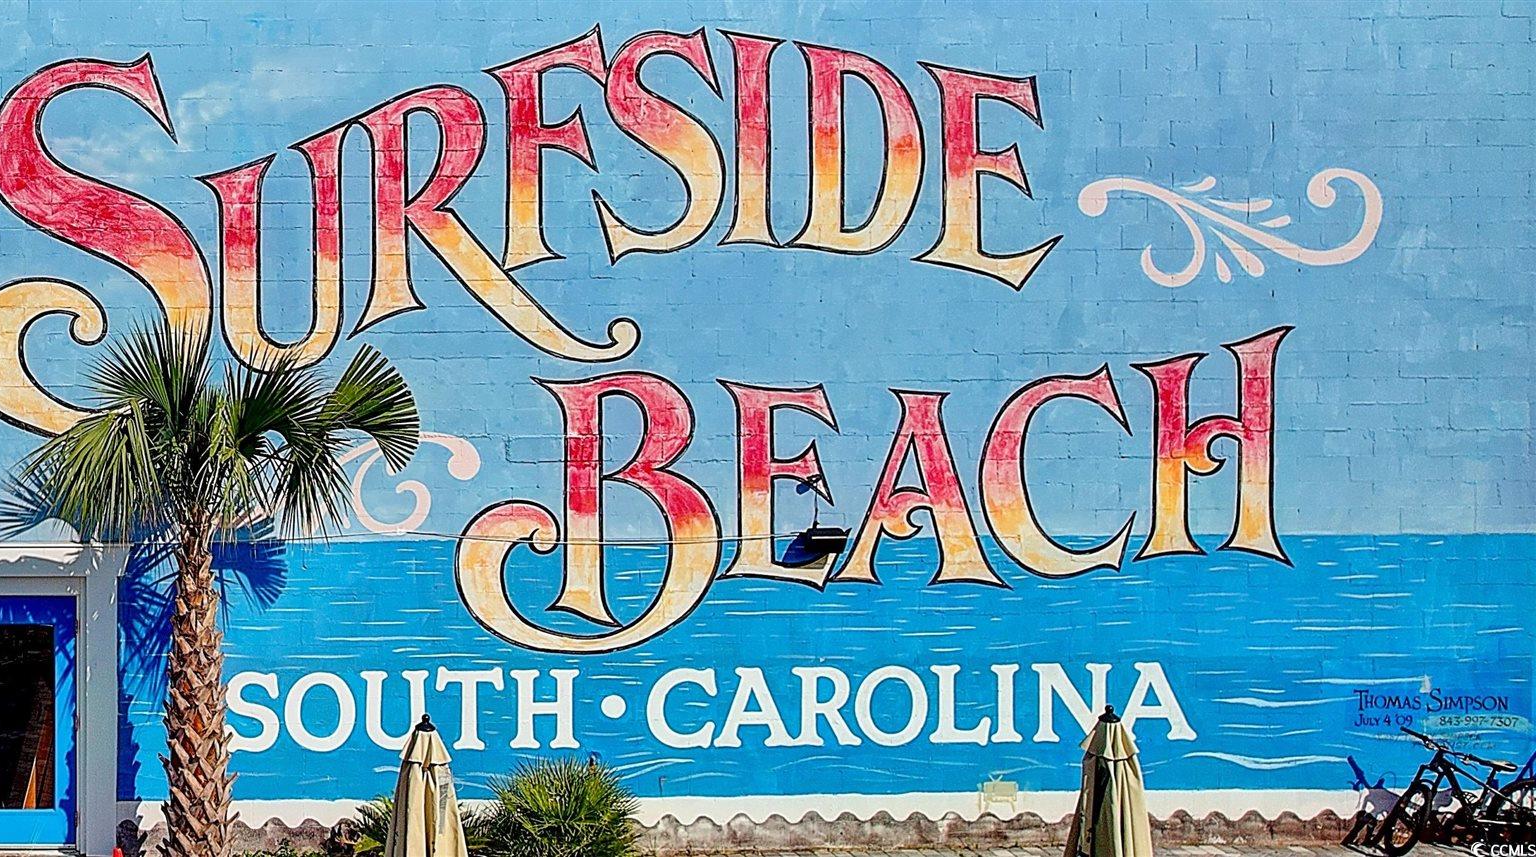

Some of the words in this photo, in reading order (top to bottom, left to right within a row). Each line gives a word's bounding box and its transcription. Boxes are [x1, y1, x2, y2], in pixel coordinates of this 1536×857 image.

[455, 325, 1295, 654] BEACH
[225, 665, 580, 752] SOUTH
[648, 662, 1197, 749] CAROLINA
[1353, 689, 1422, 711] THOMAS
[1426, 688, 1508, 712] SIMPSON
[1383, 713, 1392, 726] 4
